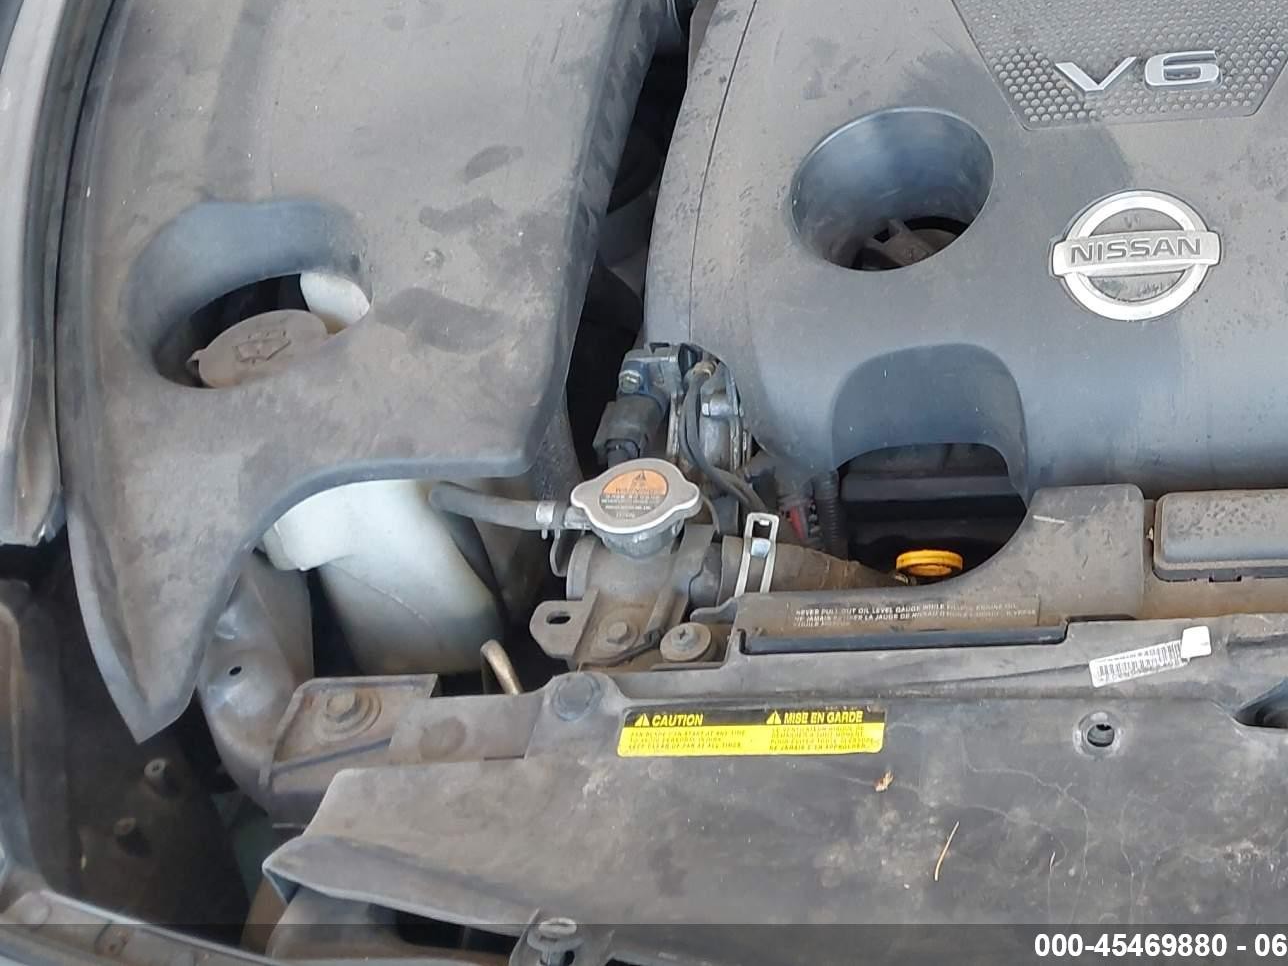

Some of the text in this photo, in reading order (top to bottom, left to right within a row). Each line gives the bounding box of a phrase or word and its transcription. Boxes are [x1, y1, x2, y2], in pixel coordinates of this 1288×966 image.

[1055, 50, 1221, 92] V6
[1071, 237, 1201, 264] NISSAN
[858, 607, 871, 615] OIL
[872, 606, 893, 614] LEVEL
[895, 605, 921, 613] GAUGE
[875, 613, 899, 621] JAUGE
[652, 713, 704, 727] CAUTION
[783, 711, 863, 724] MISE EN GARDE
